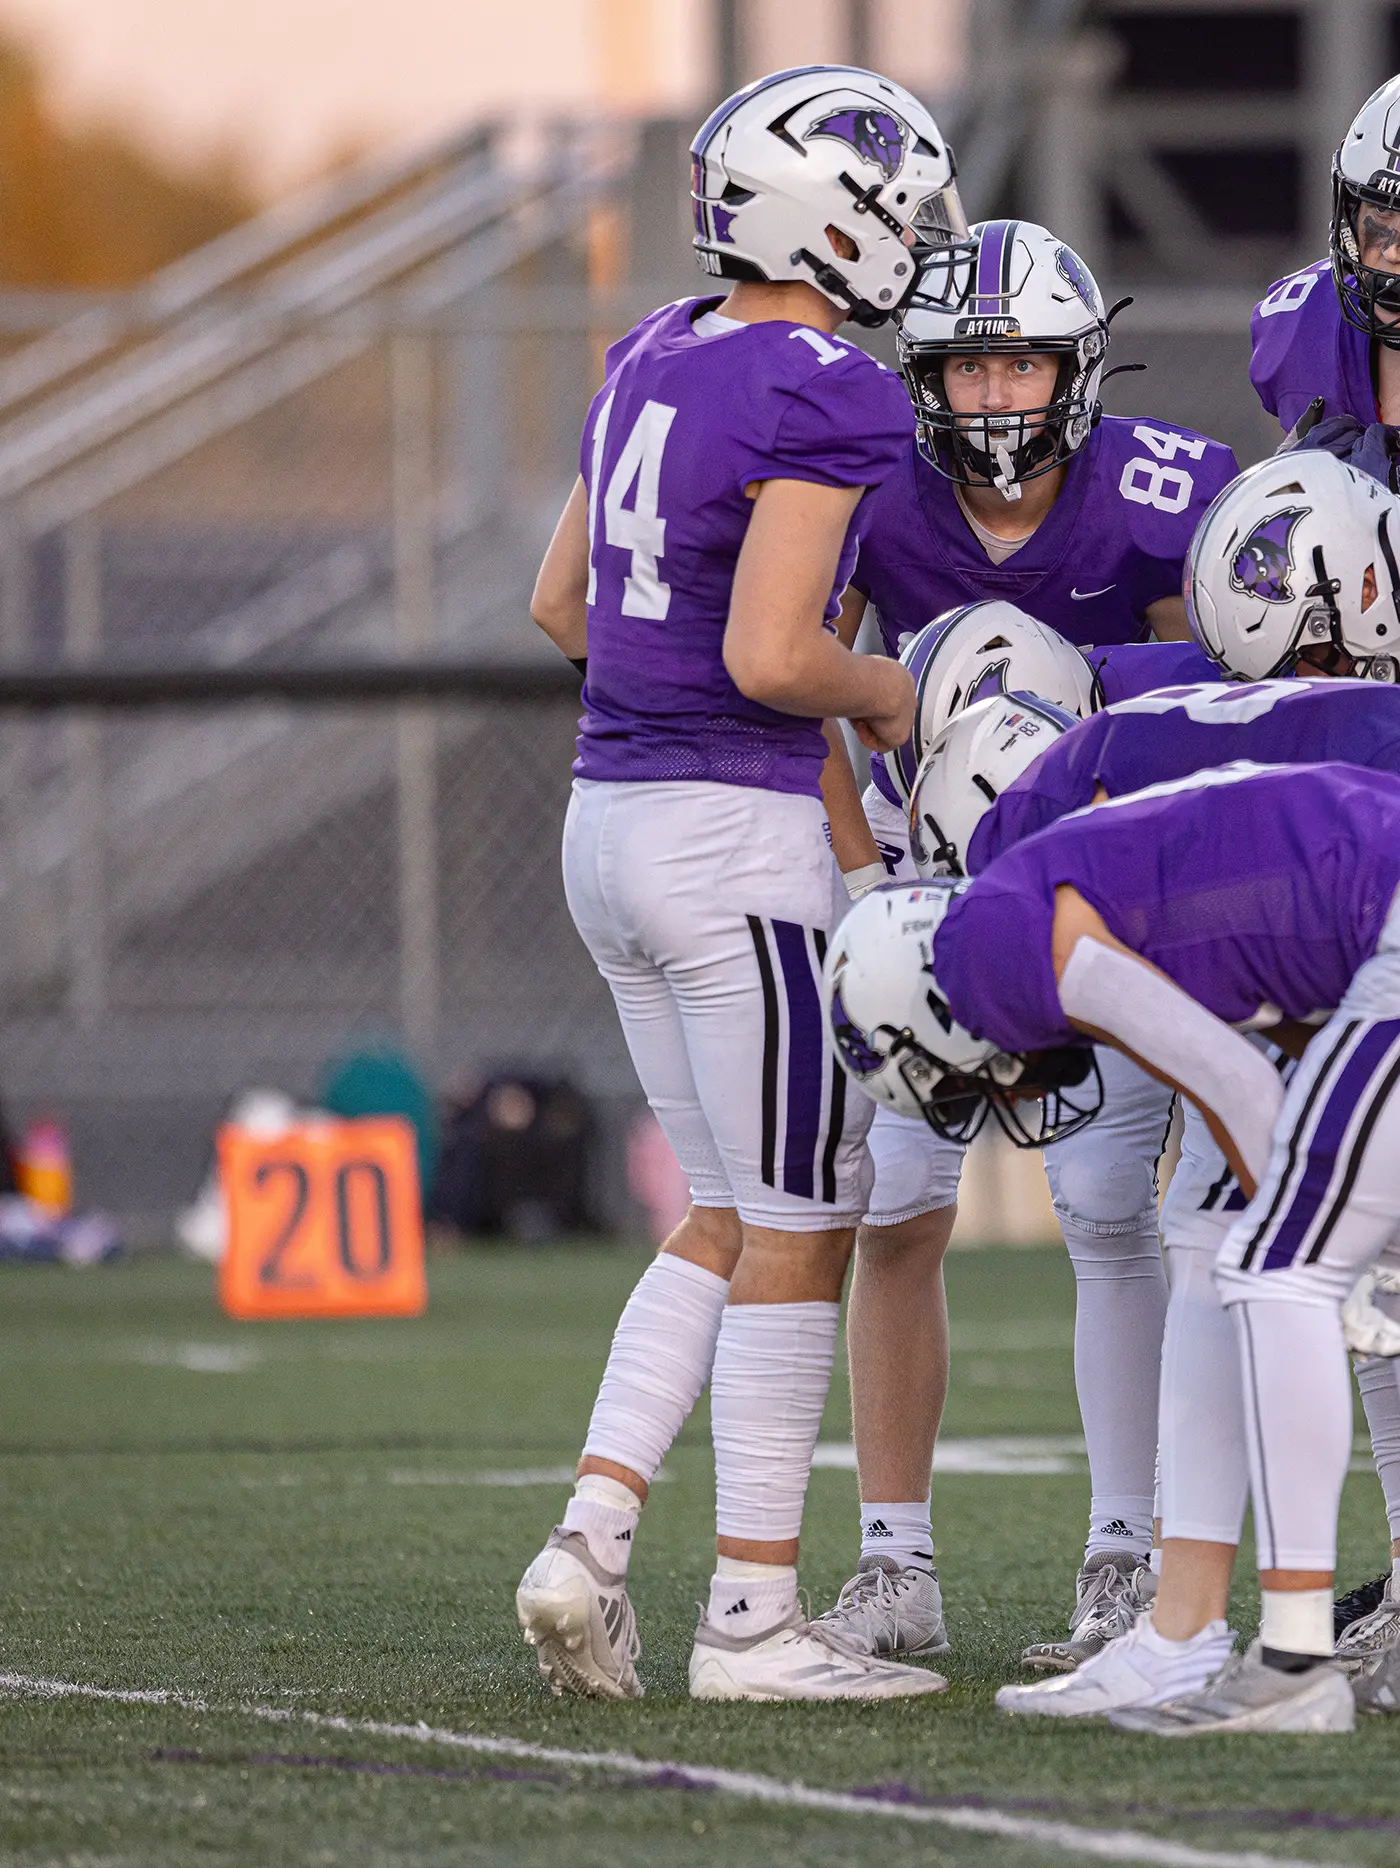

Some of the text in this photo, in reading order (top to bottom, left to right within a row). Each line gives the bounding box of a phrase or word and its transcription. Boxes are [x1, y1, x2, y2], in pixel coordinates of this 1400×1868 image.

[1341, 227, 1359, 262] Ridde
[966, 319, 1008, 335] A11IN
[1119, 425, 1207, 514] 84
[586, 389, 677, 620] 14
[1019, 721, 1040, 737] 83
[256, 1161, 391, 1289] 20
[865, 1529, 893, 1538] adidas
[1100, 1526, 1133, 1537] adidas
